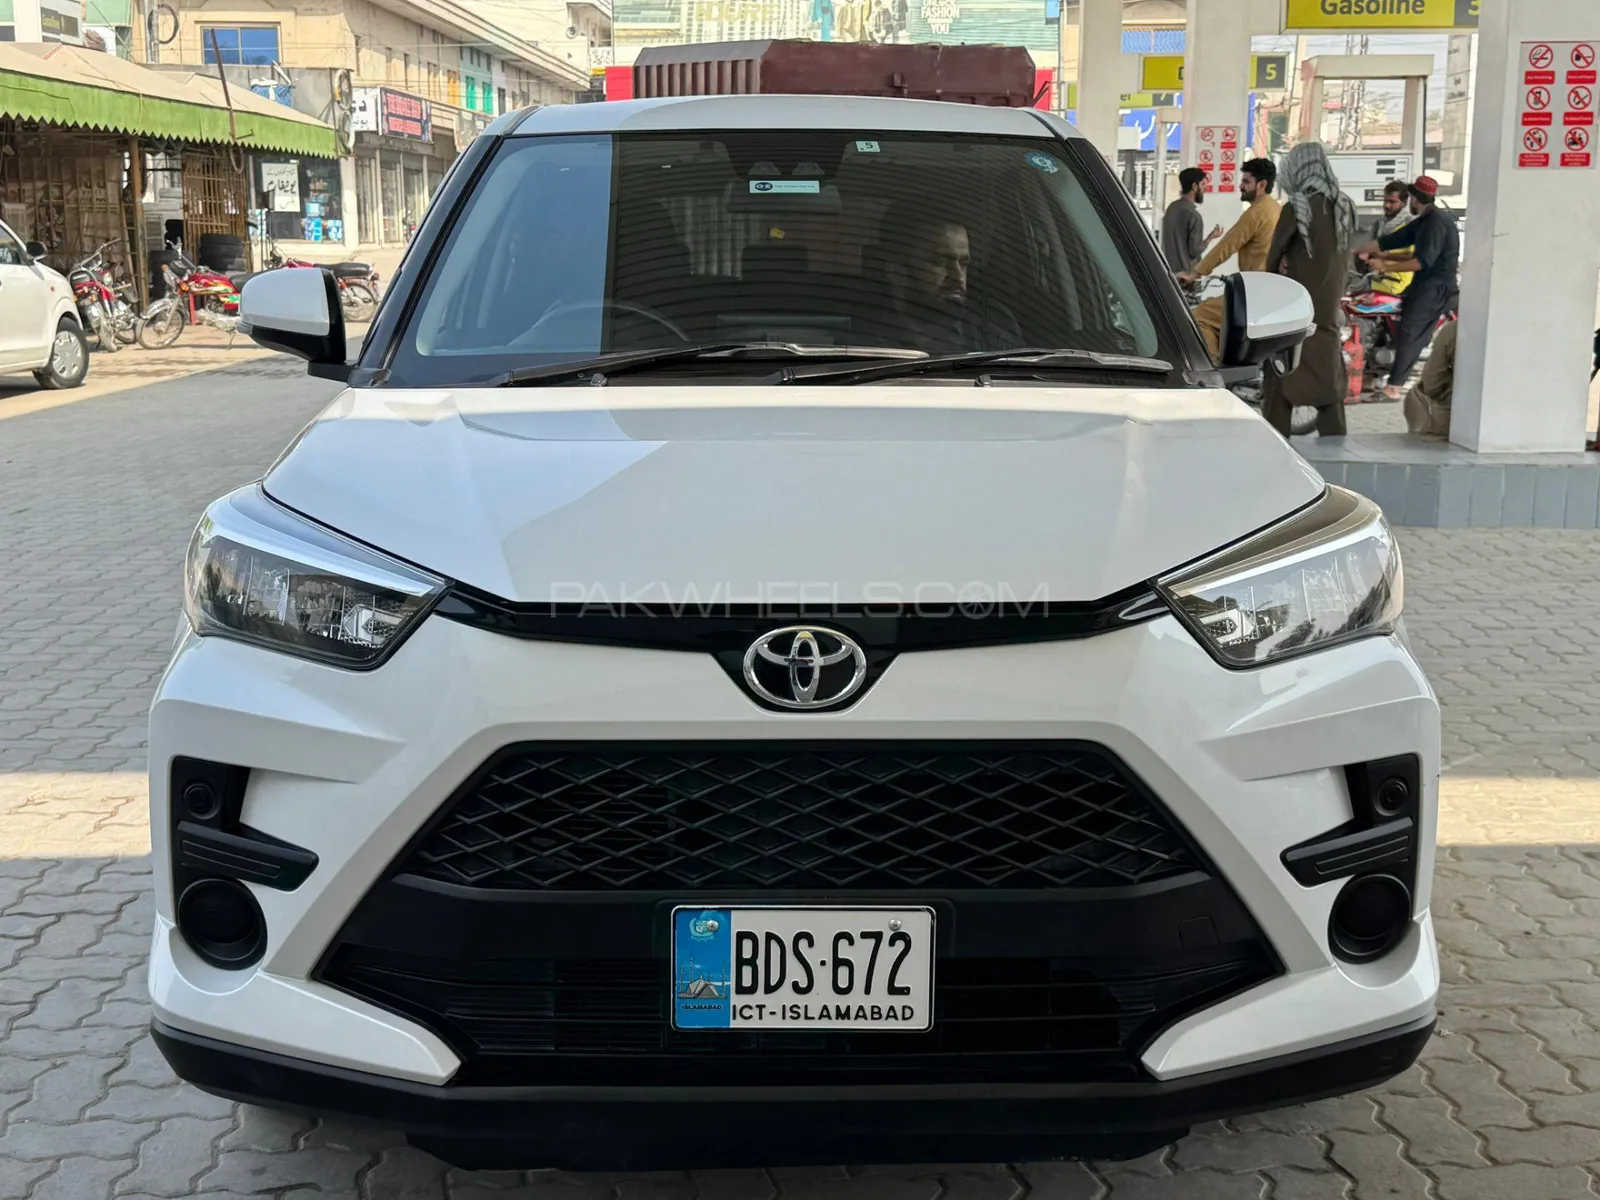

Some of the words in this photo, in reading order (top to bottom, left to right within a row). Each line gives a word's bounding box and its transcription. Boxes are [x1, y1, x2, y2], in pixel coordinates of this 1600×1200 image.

[921, 6, 960, 19] FASHION
[1320, 0, 1425, 15] Gasoline
[930, 23, 950, 35] YOU
[1265, 63, 1277, 81] 5
[681, 1003, 723, 1011] ISLAMABAD
[732, 1003, 915, 1021] ICT-ISLAMABAD
